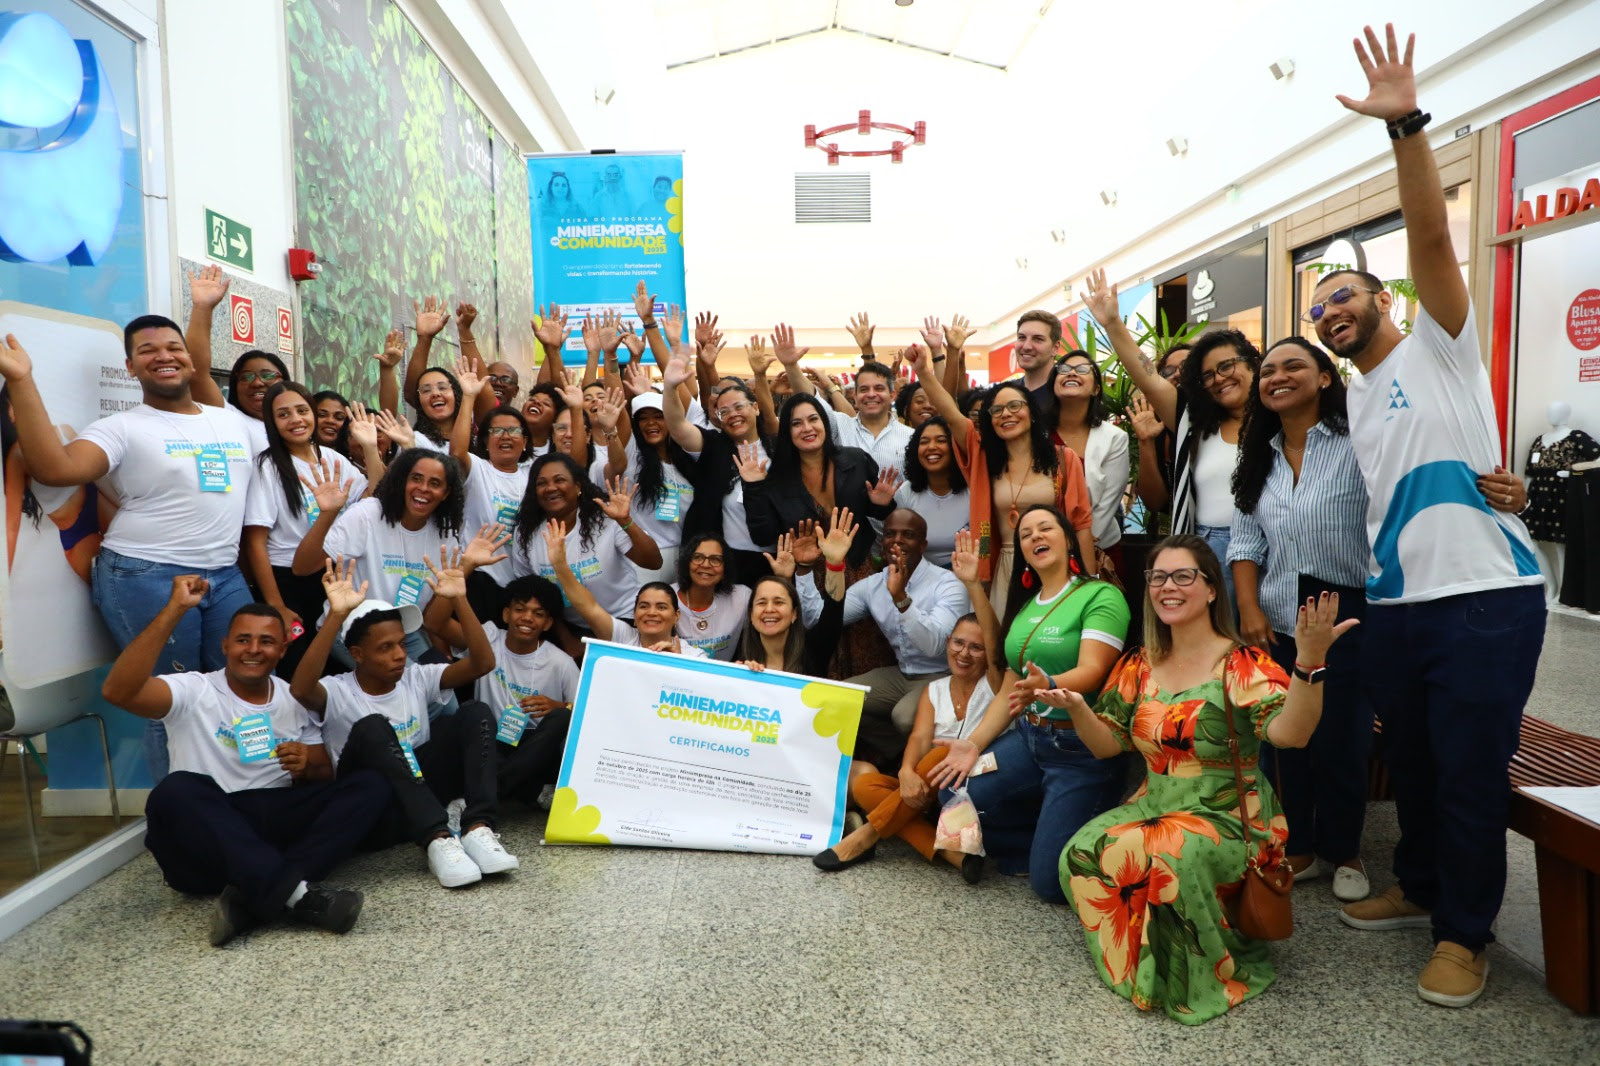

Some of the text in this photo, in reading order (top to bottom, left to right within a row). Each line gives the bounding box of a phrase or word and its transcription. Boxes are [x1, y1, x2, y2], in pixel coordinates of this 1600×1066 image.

[558, 224, 667, 238] MINIEMPRESA
[558, 236, 666, 250] COMUNIDADE
[101, 366, 139, 381] PROMOÇ
[659, 690, 782, 724] MINIEMPRESA
[657, 704, 780, 736] COMUNIDADE
[669, 736, 750, 757] CERTIFICAMOS
[756, 735, 776, 744] 2025
